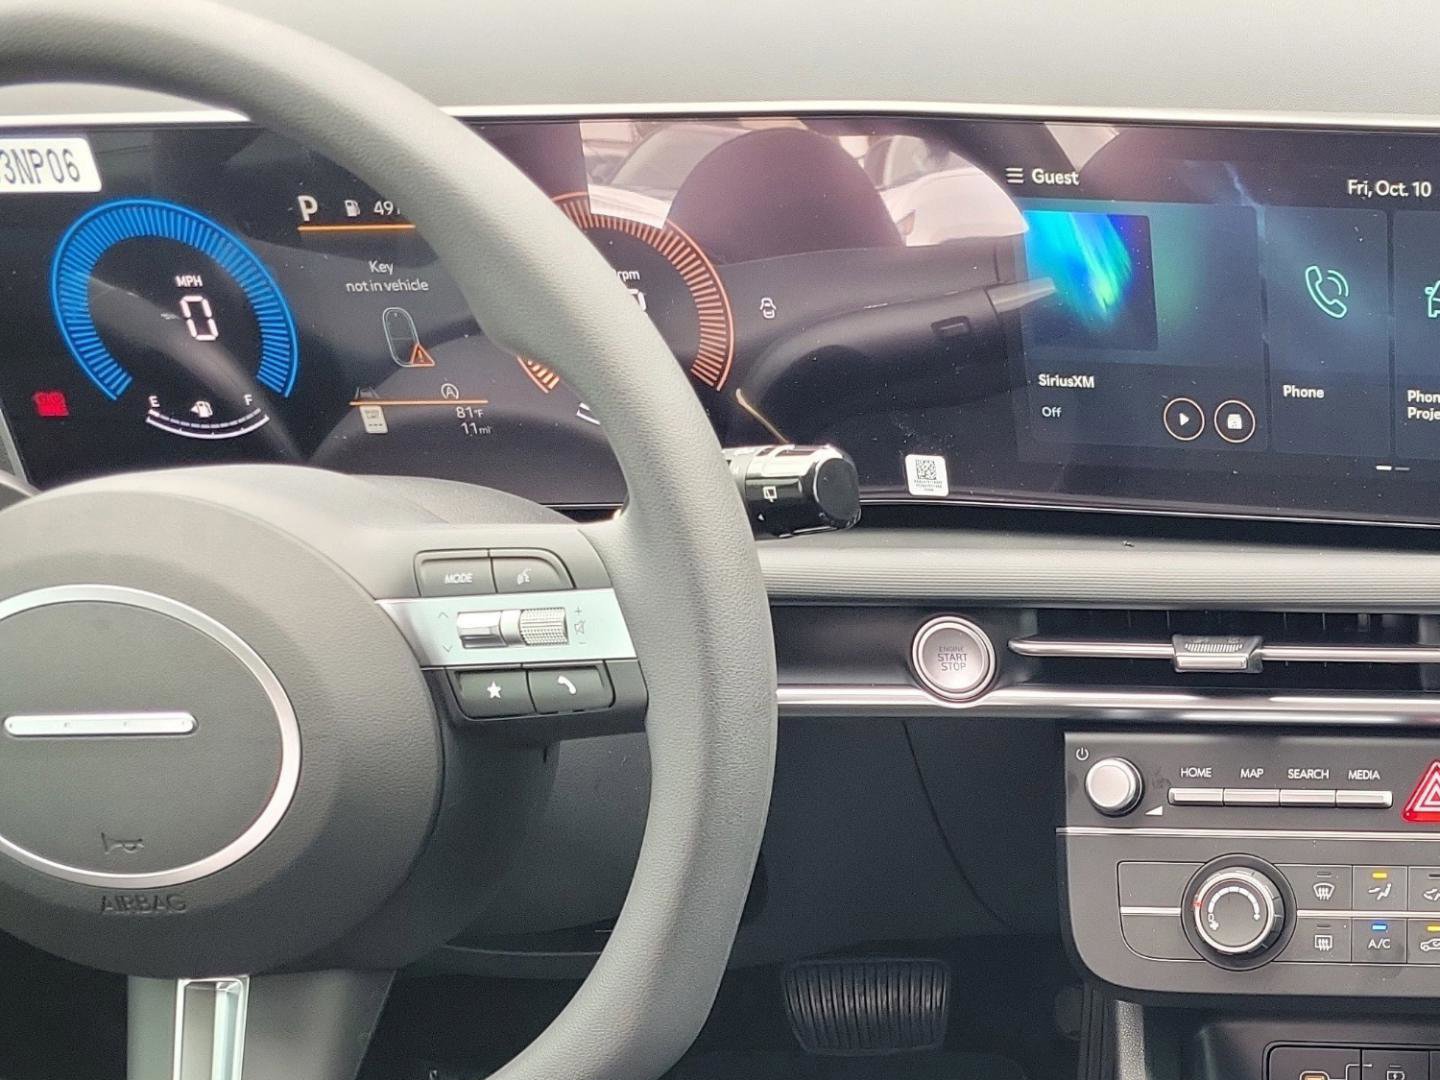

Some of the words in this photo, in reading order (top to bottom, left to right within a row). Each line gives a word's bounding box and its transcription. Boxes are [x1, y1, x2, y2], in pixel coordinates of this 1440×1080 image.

[1031, 168, 1080, 187] Guest
[1347, 179, 1373, 199] Fri,
[1375, 180, 1409, 198] Oct.
[1411, 181, 1432, 198] 10
[297, 195, 319, 222] P
[368, 260, 394, 275] Key
[175, 275, 204, 288] MPH
[345, 281, 369, 292] not
[370, 279, 383, 292] in
[383, 278, 430, 292] vehicle
[179, 295, 219, 342] 0
[1037, 373, 1096, 389] SiriusXM
[1282, 384, 1325, 399] Phone
[1041, 404, 1062, 418] Off
[444, 573, 473, 584] MODE
[937, 653, 968, 662] START
[941, 662, 967, 672] STOP
[1180, 767, 1212, 778] HOME
[1240, 768, 1264, 779] MAP
[1287, 768, 1329, 780] SEARCH
[1348, 769, 1380, 780] MEDIA
[1368, 938, 1391, 950] A/C
